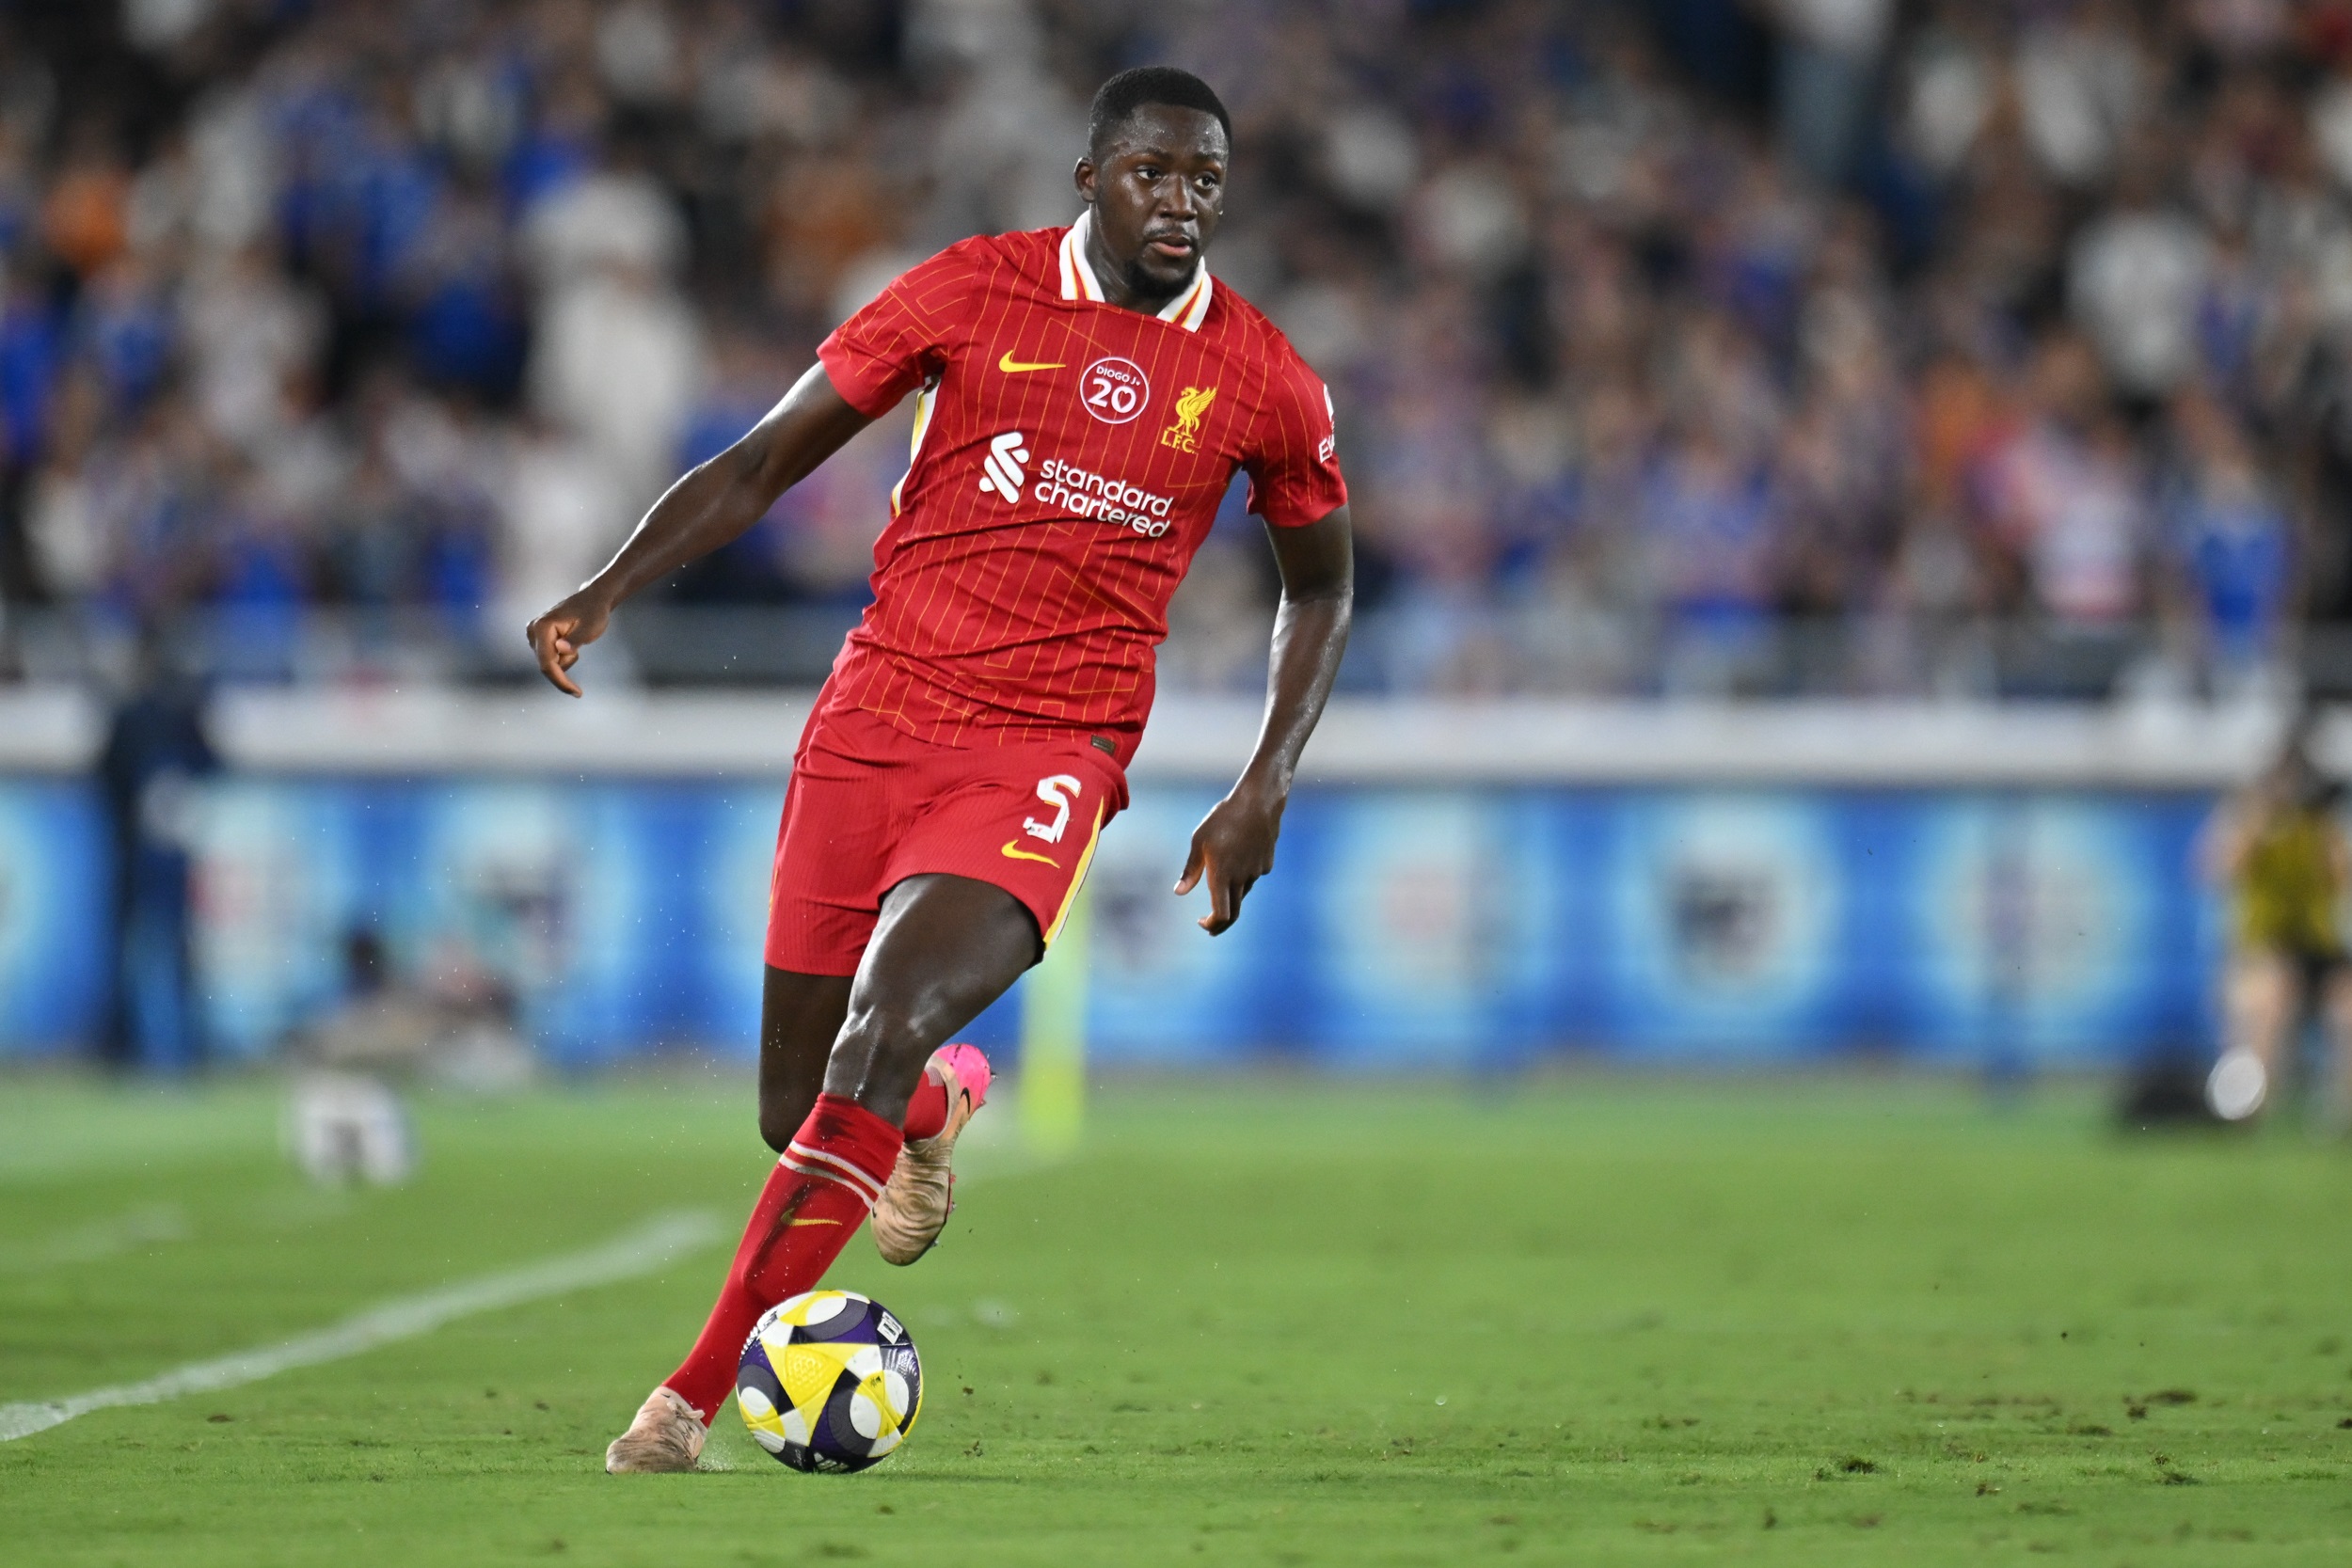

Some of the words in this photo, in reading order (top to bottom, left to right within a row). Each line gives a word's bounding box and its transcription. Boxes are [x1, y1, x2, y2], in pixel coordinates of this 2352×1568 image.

[1088, 377, 1136, 414] 20
[1096, 365, 1130, 383] DIOGO
[1034, 480, 1171, 538] chartered
[1040, 459, 1174, 517] standard
